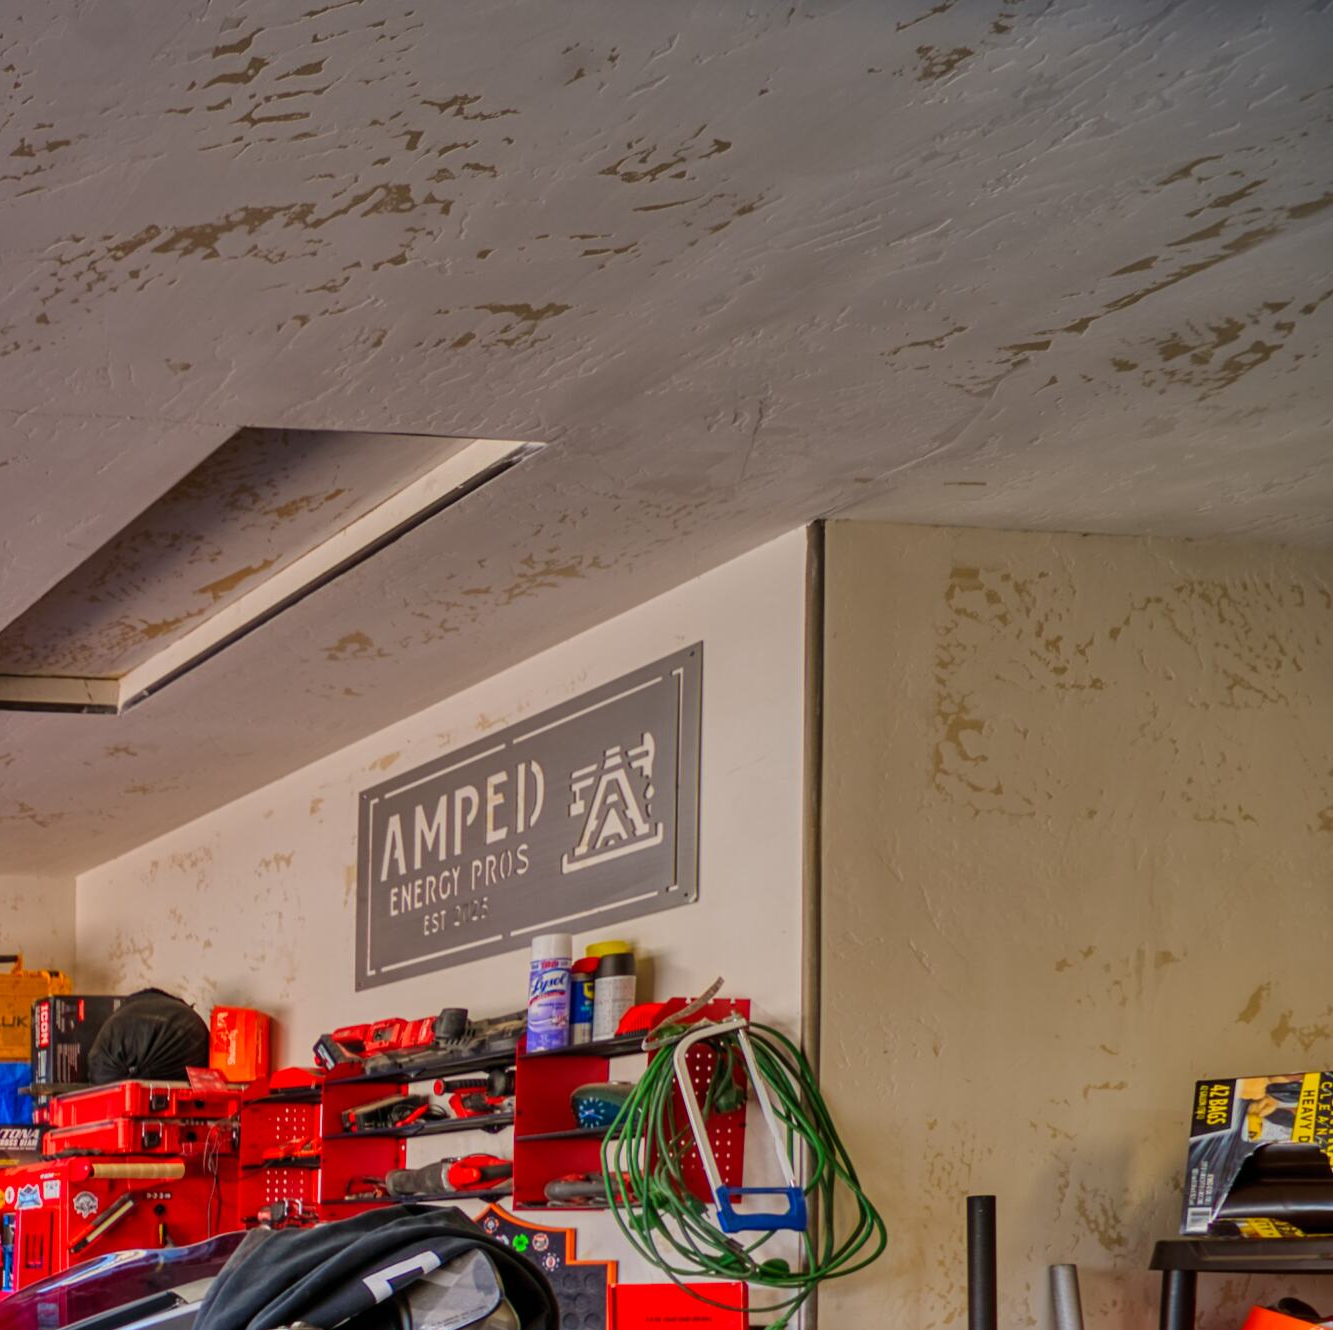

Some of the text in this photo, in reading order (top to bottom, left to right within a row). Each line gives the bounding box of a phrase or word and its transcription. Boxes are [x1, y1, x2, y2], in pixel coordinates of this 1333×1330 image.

[381, 760, 544, 882] AMPED
[390, 844, 529, 916] ENERGY PROS
[424, 910, 447, 936] EST
[533, 972, 568, 994] Lysol
[40, 1002, 50, 1046] ICON
[1206, 1084, 1230, 1125] 42 BAGS
[1299, 1089, 1315, 1130] HEAVY
